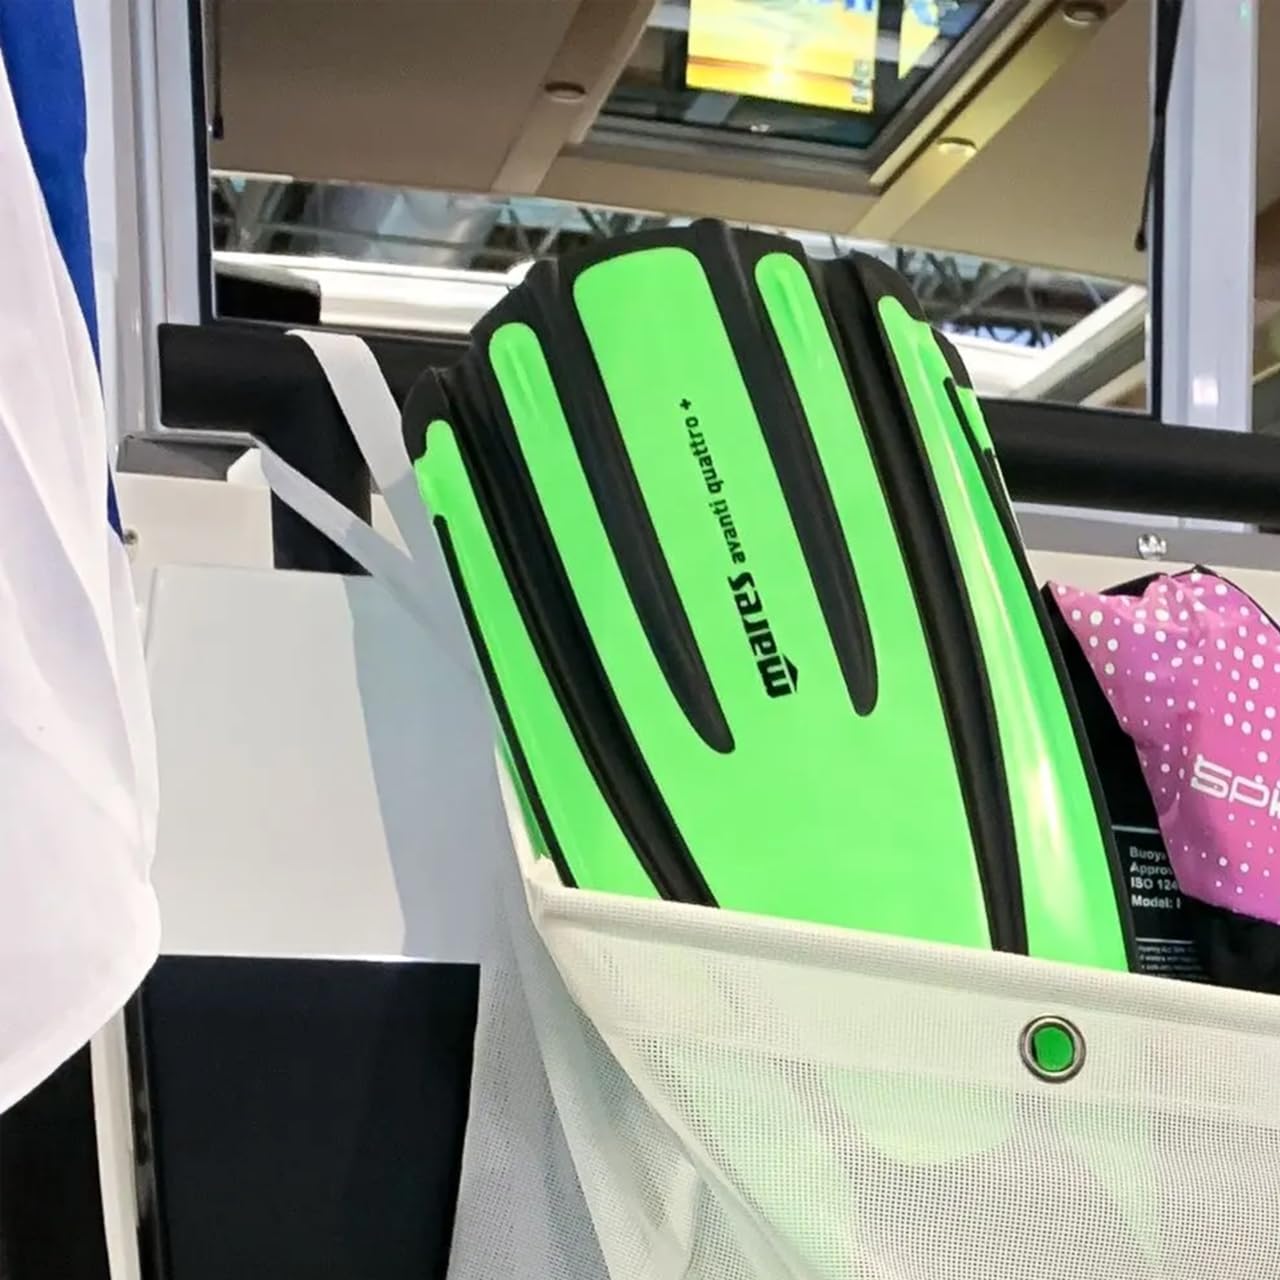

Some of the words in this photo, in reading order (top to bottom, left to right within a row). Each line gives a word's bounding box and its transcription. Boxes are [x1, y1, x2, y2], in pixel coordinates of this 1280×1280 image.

[685, 416, 724, 494] quattro
[711, 499, 746, 564] avanti
[728, 572, 799, 698] mares
[1130, 877, 1154, 890] ISO
